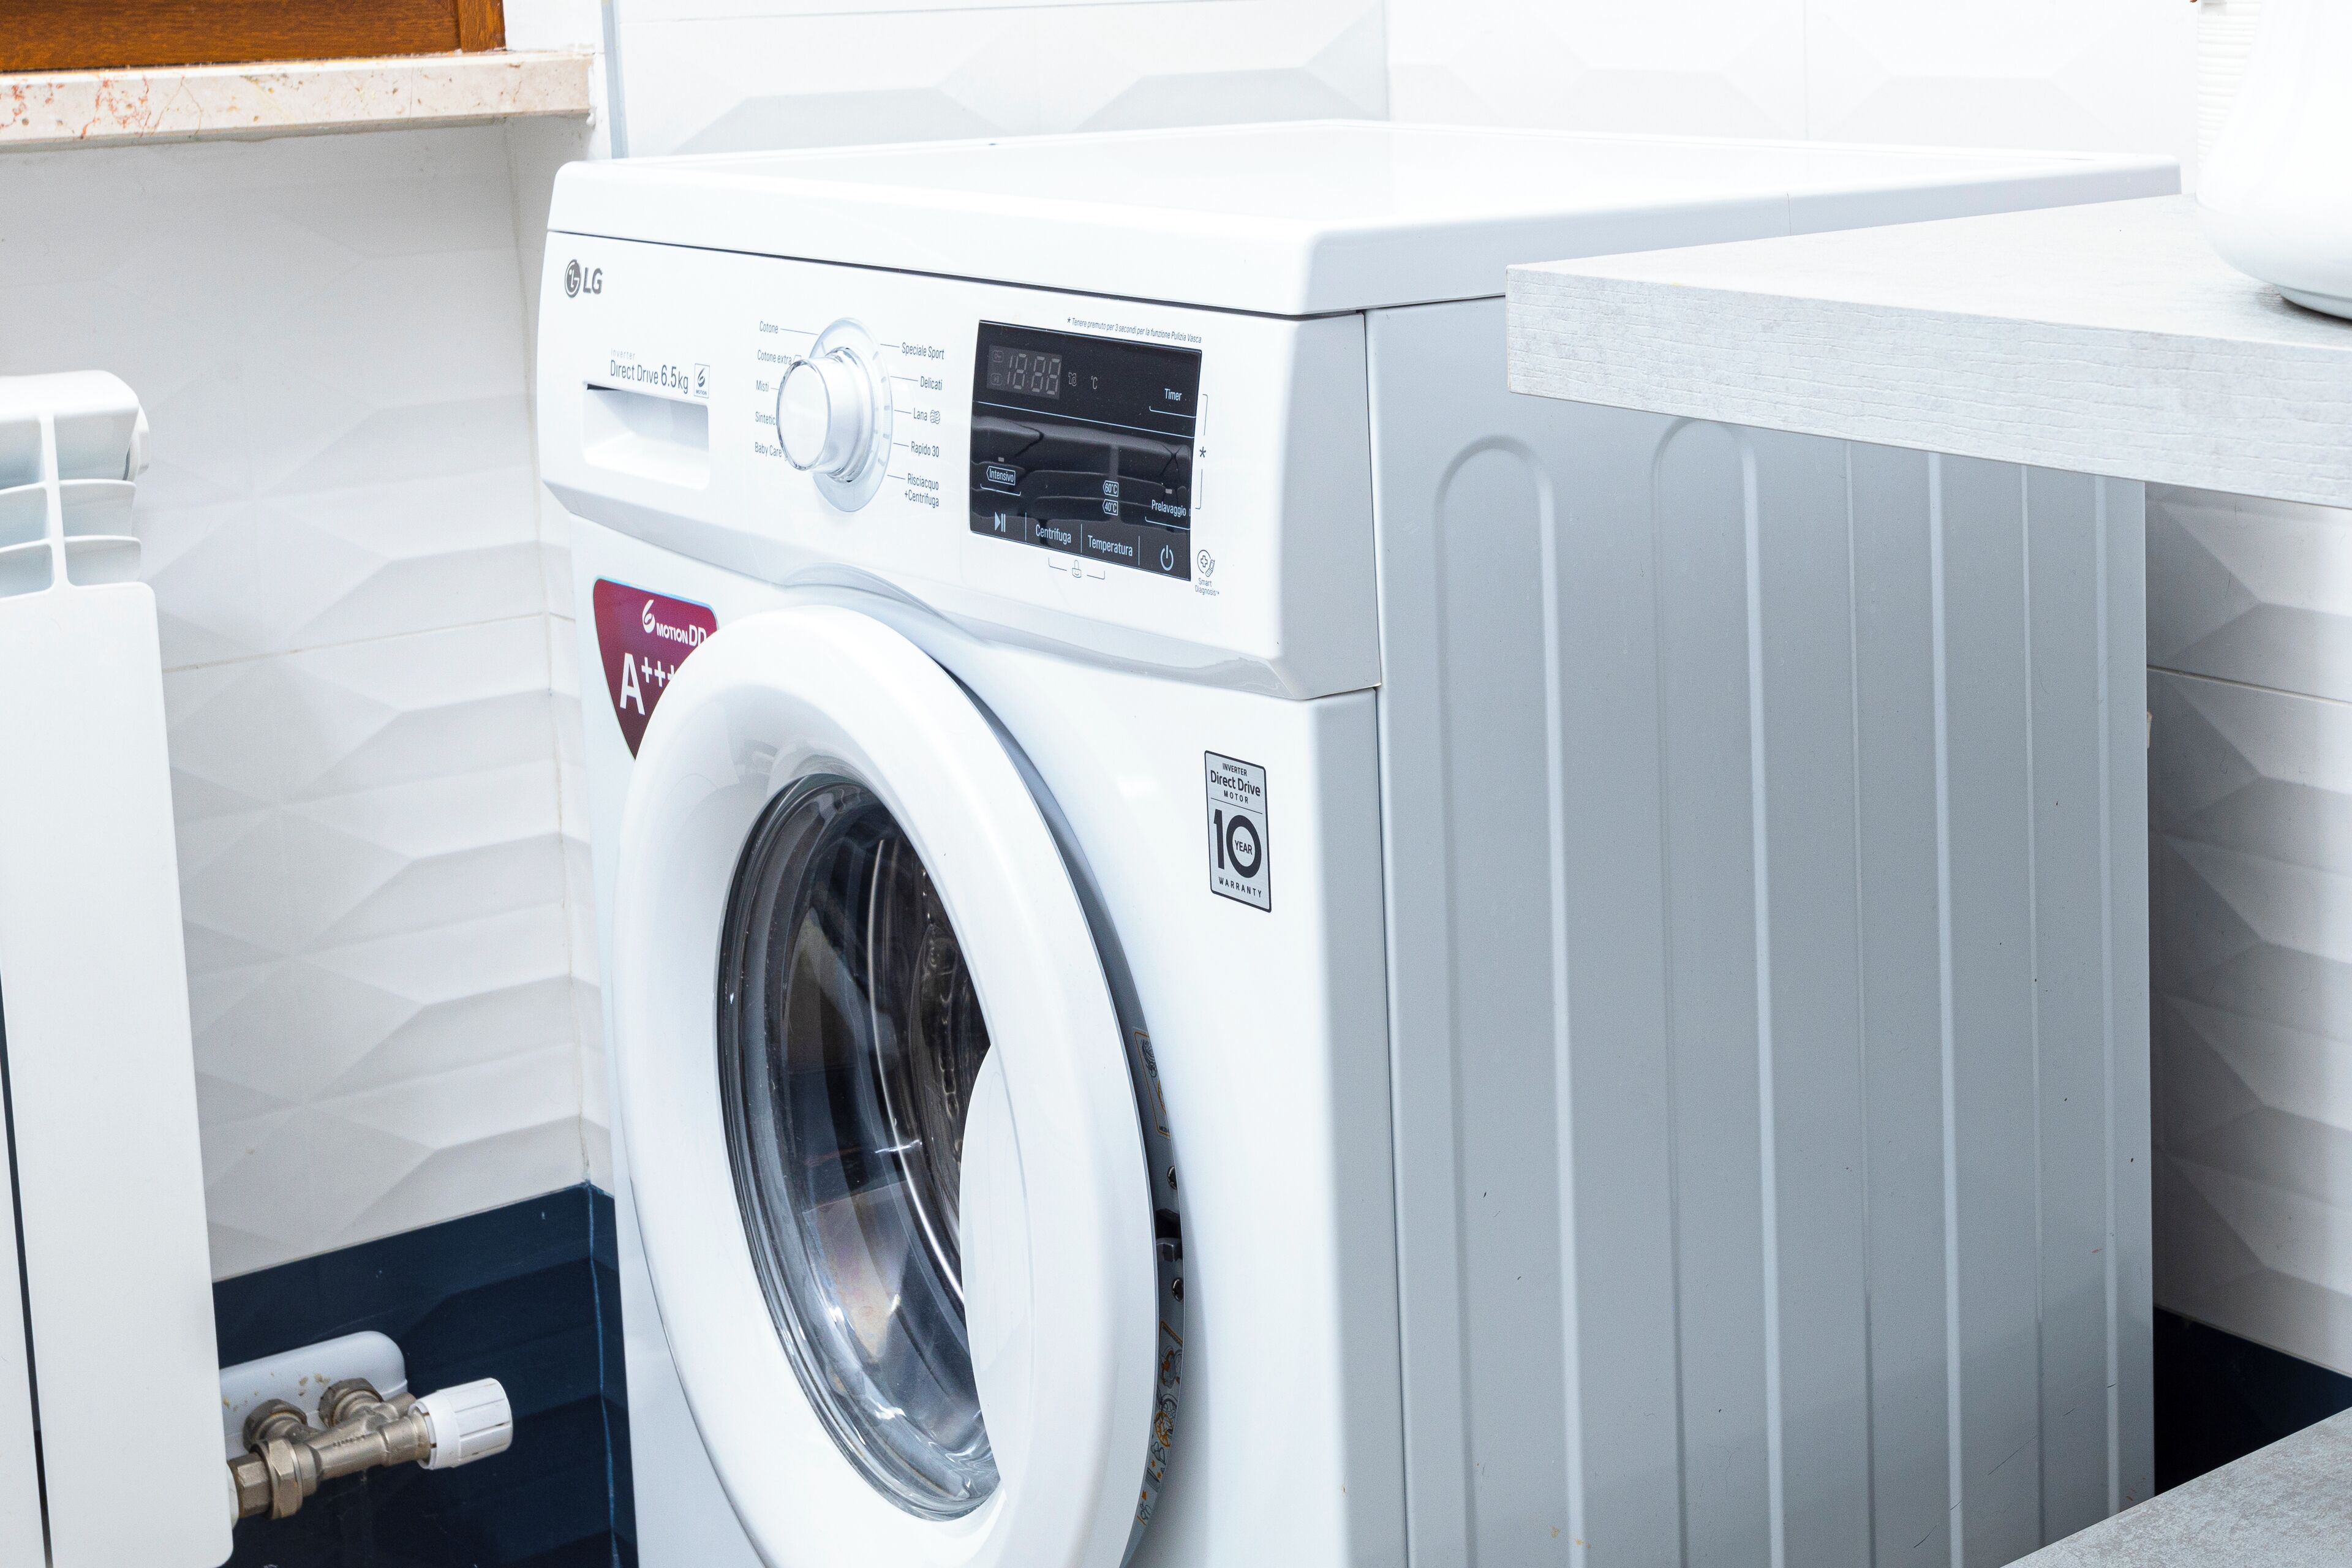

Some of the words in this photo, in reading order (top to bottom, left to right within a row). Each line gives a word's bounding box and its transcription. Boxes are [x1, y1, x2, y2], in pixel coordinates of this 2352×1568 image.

[583, 267, 603, 294] LG
[760, 320, 778, 334] Cotone
[1072, 318, 1087, 327] Tenere
[1151, 329, 1170, 339] funzione
[1171, 331, 1186, 341] Pulizia
[1188, 334, 1202, 343] Vasca
[757, 349, 777, 363] Cotone
[777, 355, 792, 365] extra
[902, 342, 927, 356] Speciale
[928, 346, 944, 360] Sport
[610, 360, 635, 380] Direct
[637, 364, 659, 385] Drive
[756, 380, 769, 392] Misti
[921, 375, 943, 391] Delicati
[1164, 388, 1182, 401] Timer
[755, 411, 777, 426] Sintetic
[913, 407, 927, 421] Lana
[755, 442, 769, 457] Baby
[769, 445, 782, 458] Care
[911, 441, 931, 456] Rapido
[932, 445, 940, 458] 30
[908, 473, 939, 491] Risciacquo
[989, 468, 1014, 483] Intensivo
[1104, 483, 1117, 494] 60°C
[1104, 501, 1117, 513] 40°C
[1152, 499, 1186, 518] Prelavaggio
[1035, 524, 1071, 545] Centrifuga
[1088, 535, 1133, 557] Temperatura
[1199, 578, 1212, 587] Smart
[1222, 763, 1247, 777] INVERTER
[1210, 769, 1236, 789] Direct
[1238, 778, 1261, 796] Drive
[1224, 790, 1248, 804] MOTOR
[1213, 809, 1262, 878] 10
[1235, 840, 1253, 855] YEAR
[1218, 876, 1262, 898] WARRANTY
